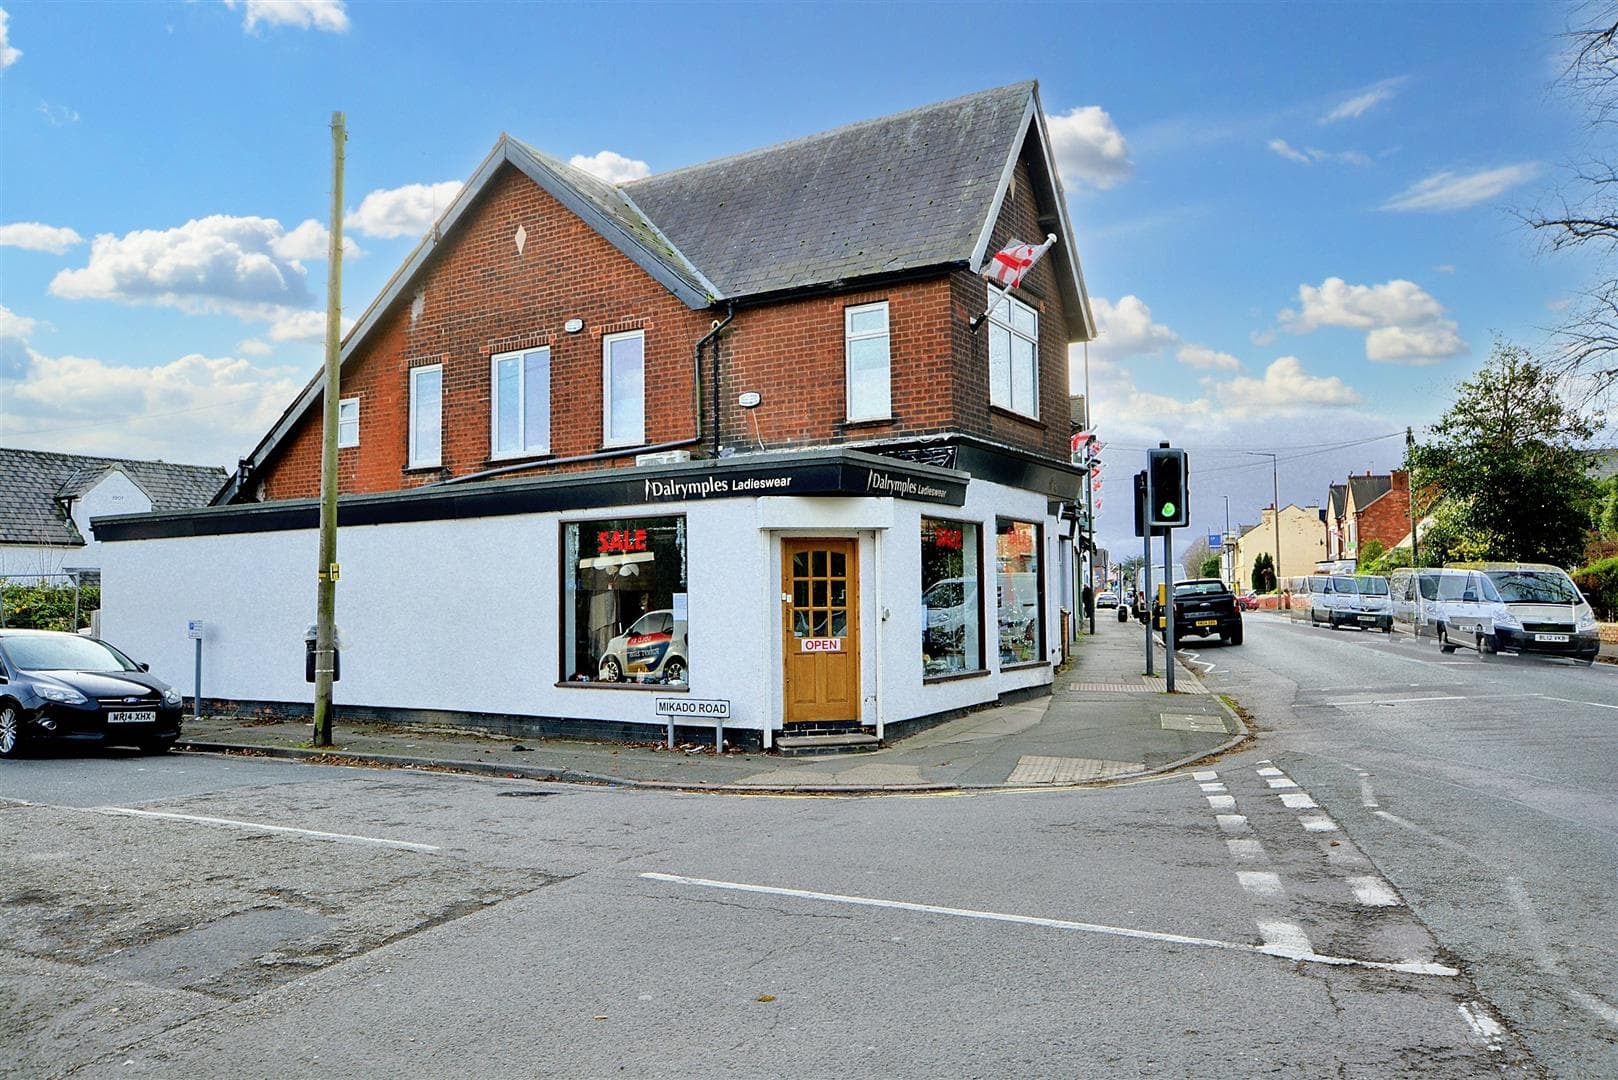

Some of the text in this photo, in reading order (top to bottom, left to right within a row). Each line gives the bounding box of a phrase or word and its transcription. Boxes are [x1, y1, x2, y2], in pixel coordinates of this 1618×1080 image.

[652, 476, 792, 499] Dalrymples Ladieswear
[872, 473, 947, 498] Dalrymples Ladieswear
[598, 529, 647, 552] SALE
[805, 640, 837, 650] OPEN
[134, 712, 151, 721] XHX
[658, 702, 727, 714] MIKADO ROAD
